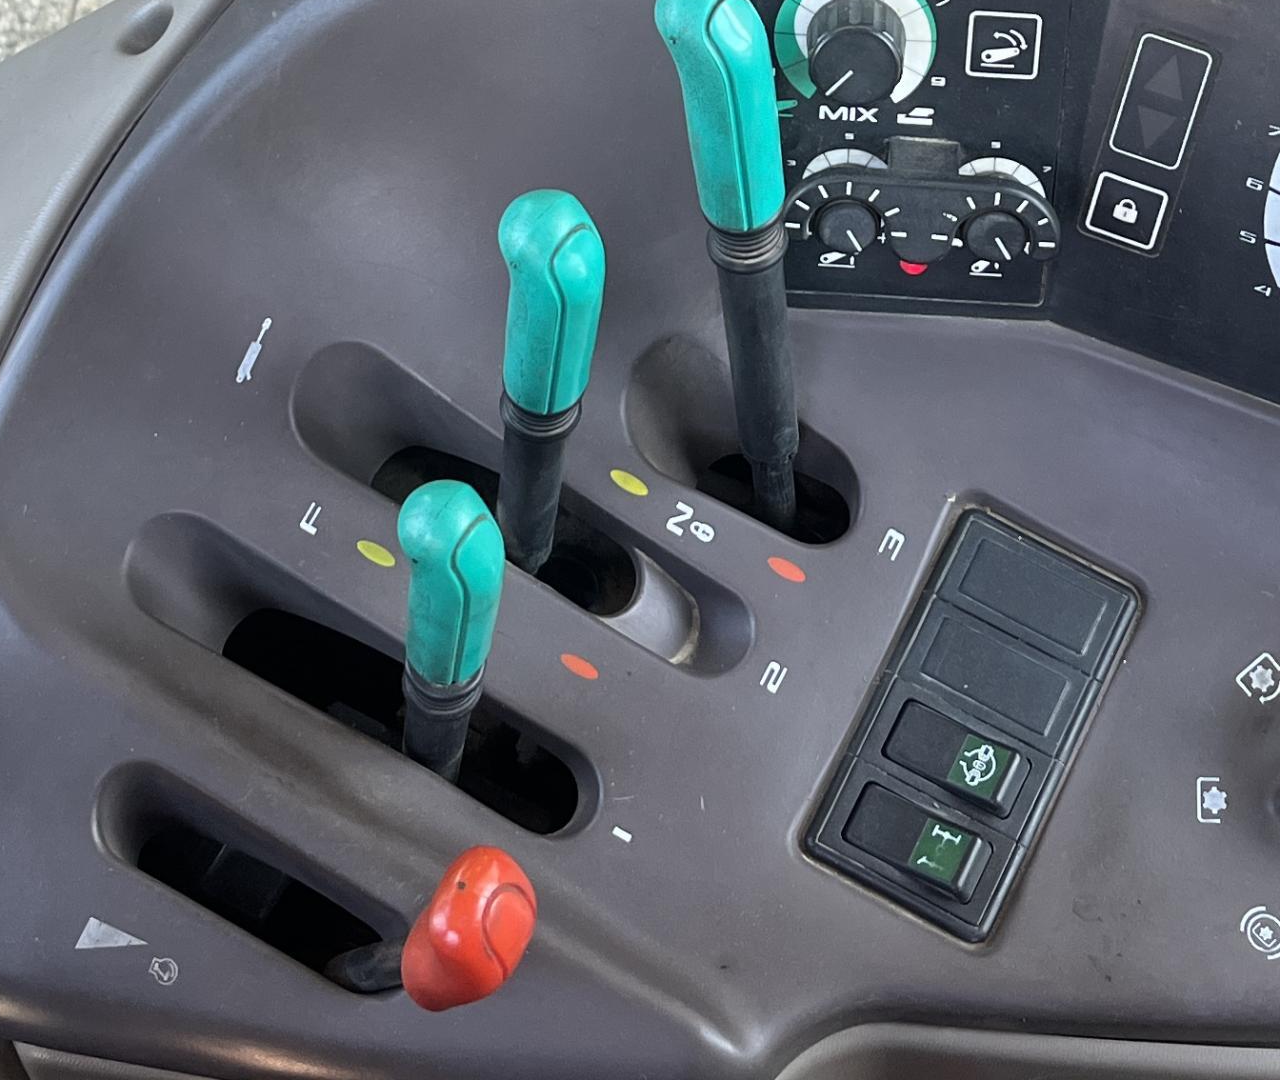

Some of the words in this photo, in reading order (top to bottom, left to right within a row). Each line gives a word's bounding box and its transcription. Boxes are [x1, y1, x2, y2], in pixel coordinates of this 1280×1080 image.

[930, 75, 946, 87] 9
[818, 104, 879, 123] MIX
[1245, 177, 1264, 191] 6
[1239, 230, 1257, 244] 5
[1253, 284, 1272, 297] 4
[299, 501, 322, 536] F
[878, 528, 906, 561] 3
[759, 661, 788, 694] 2
